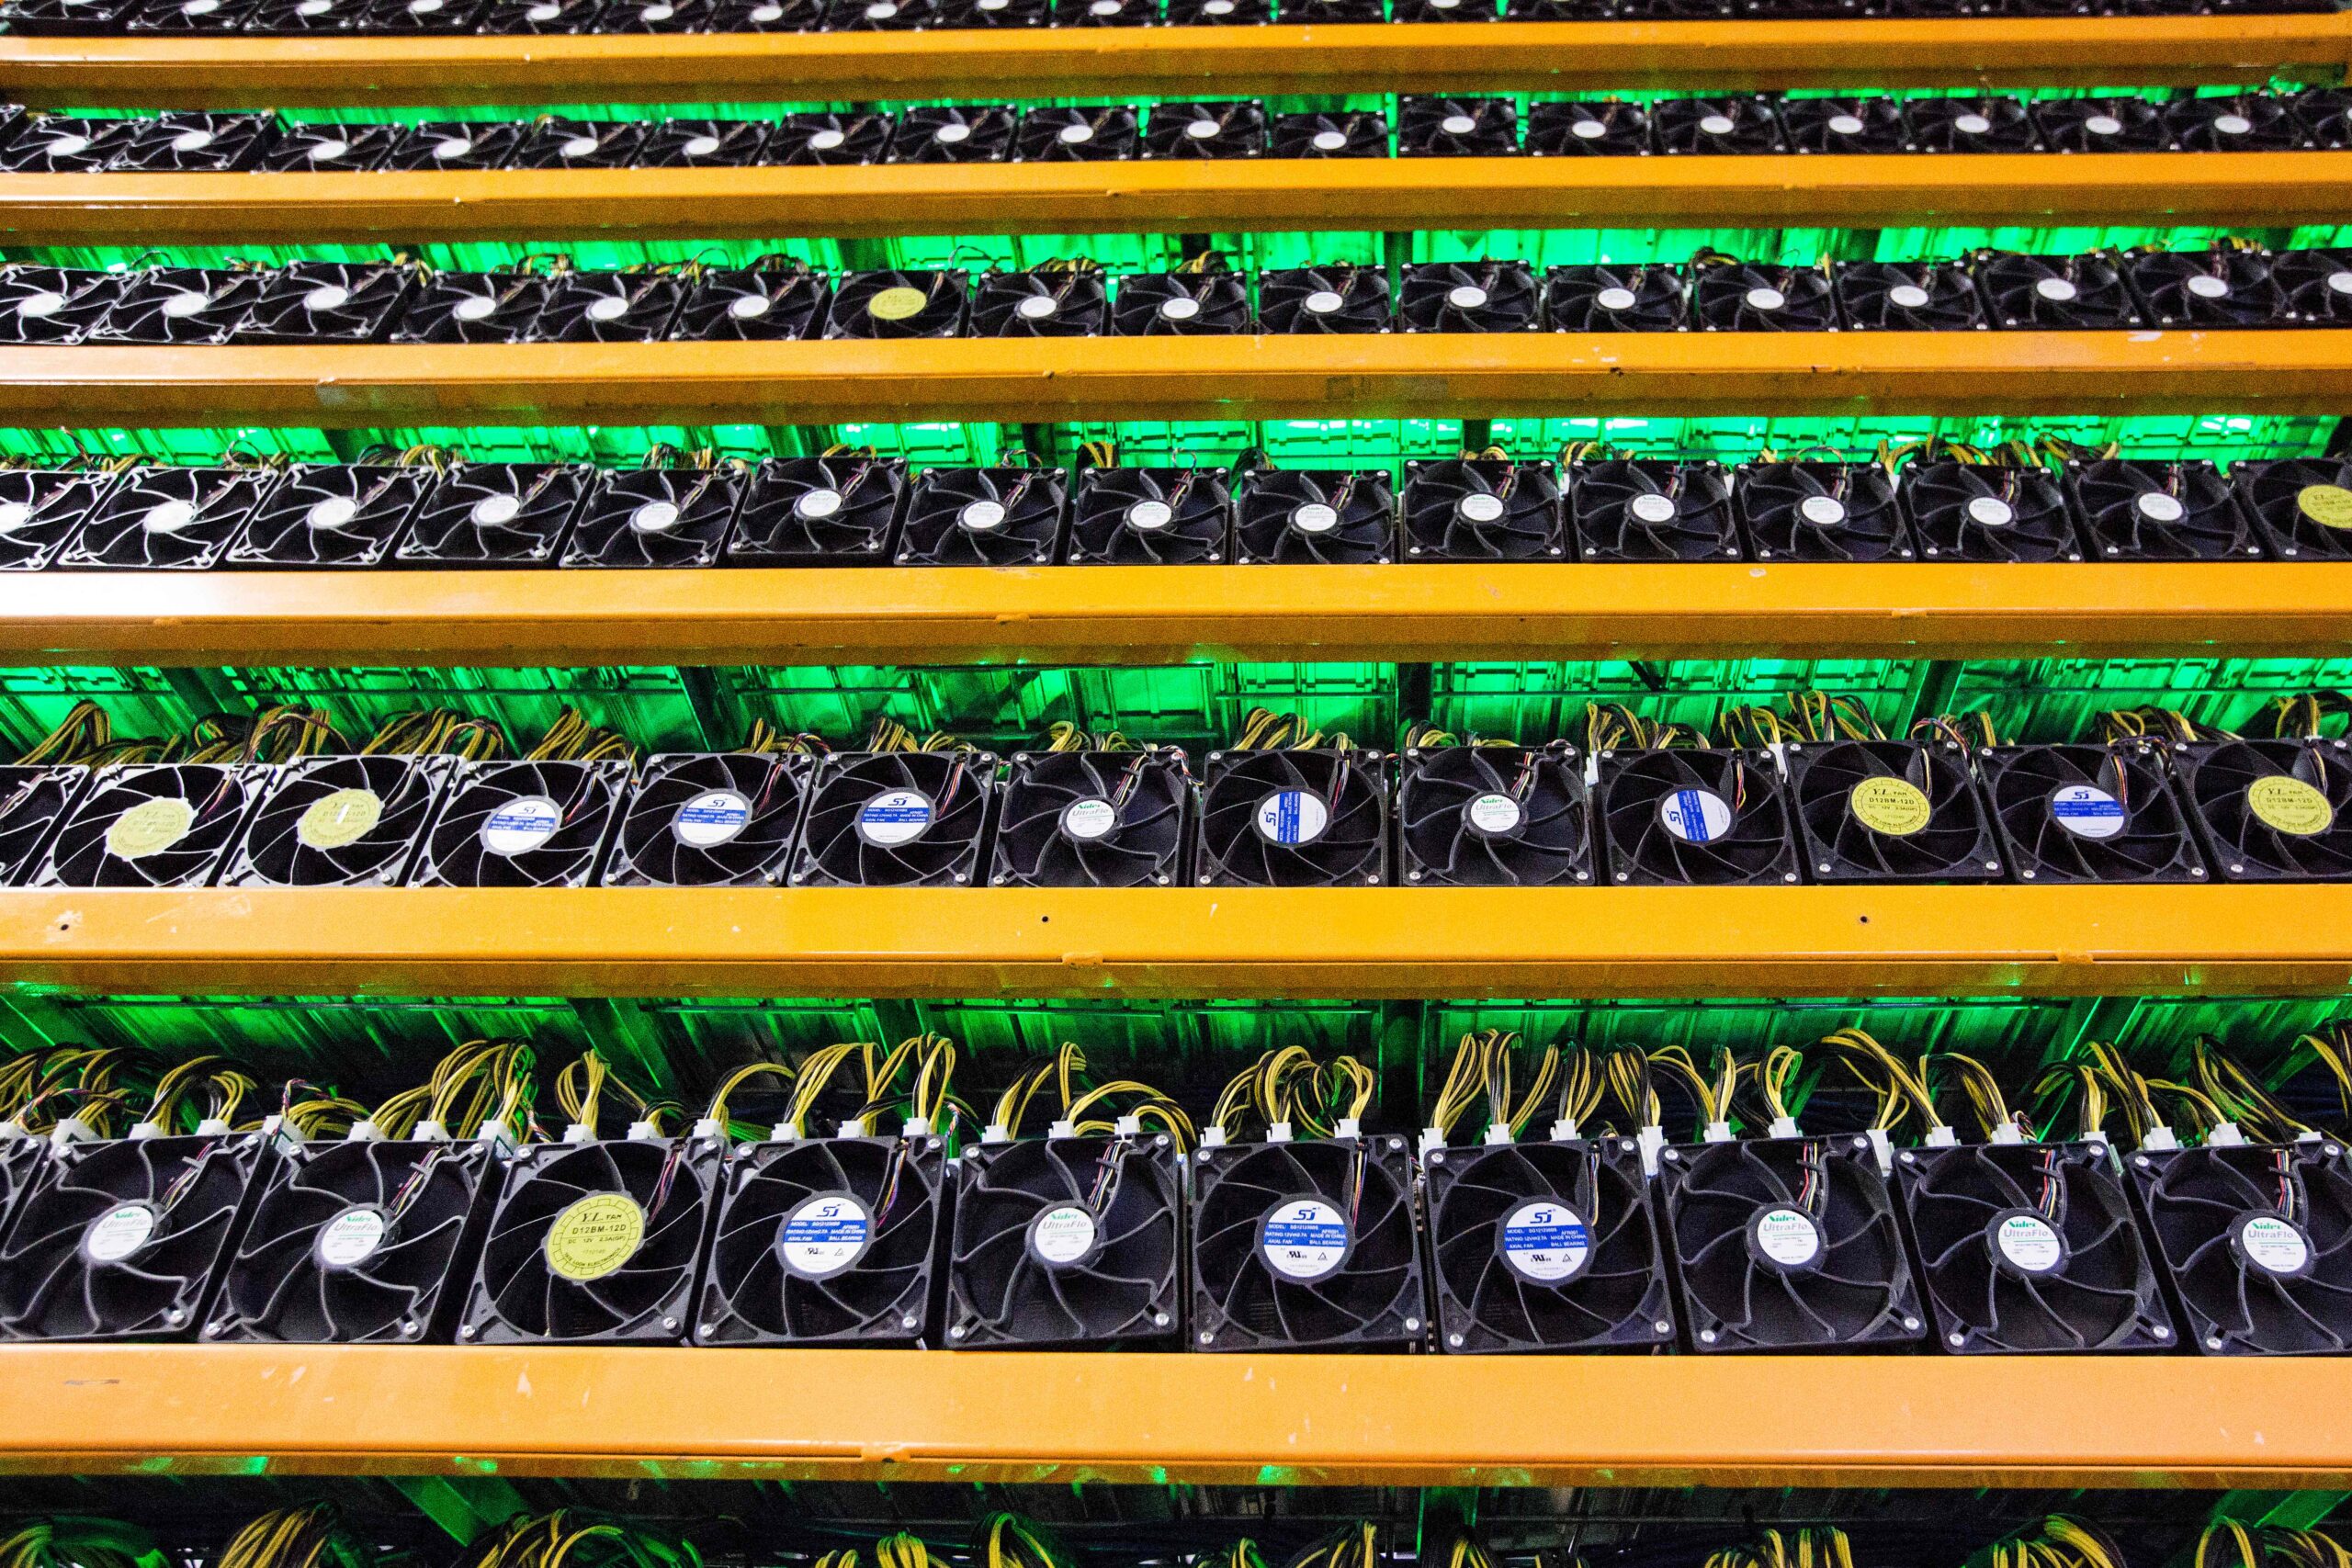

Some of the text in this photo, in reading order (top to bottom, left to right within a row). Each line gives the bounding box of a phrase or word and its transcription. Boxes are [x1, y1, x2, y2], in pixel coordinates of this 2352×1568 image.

[1043, 1221, 1087, 1229] UltraFlo
[1763, 1223, 1808, 1232] UltraFlo
[2008, 1220, 2037, 1228] Nidec
[572, 1224, 627, 1235] D12BM-12D
[2004, 1229, 2049, 1237] UltraFlo
[2247, 1230, 2294, 1238] UltraFlo
